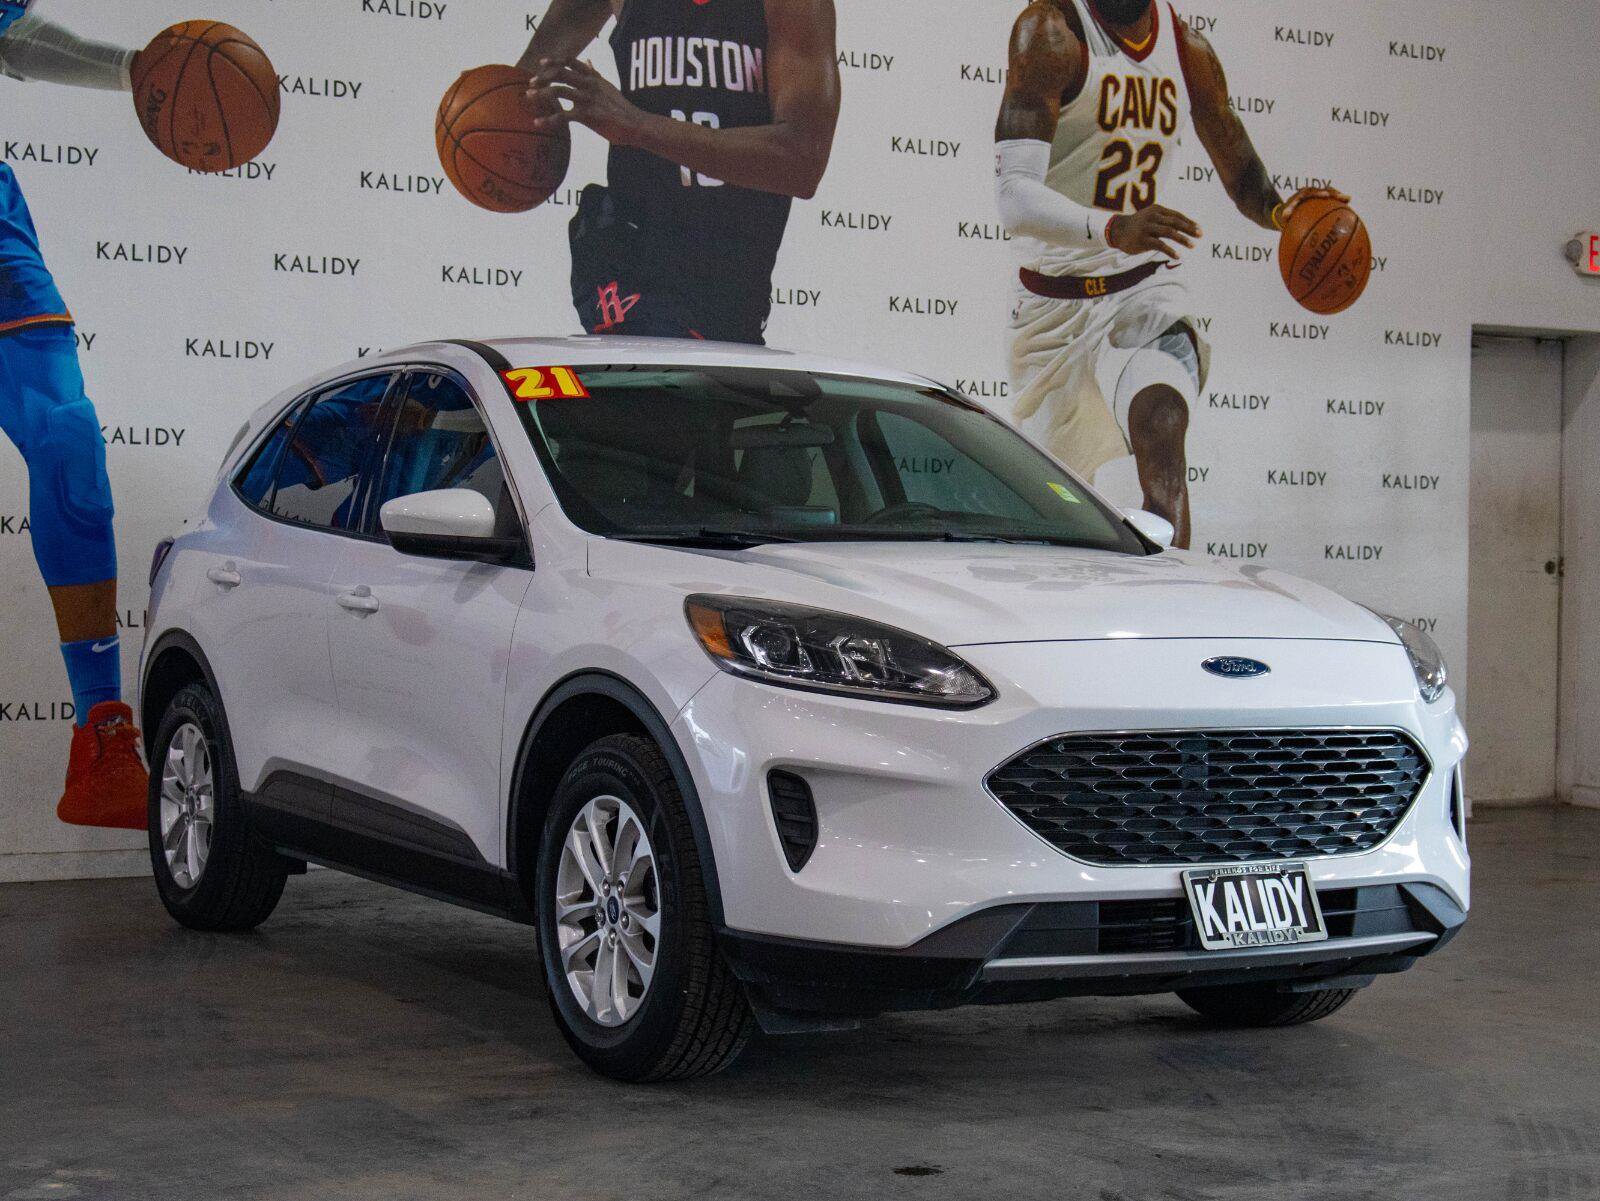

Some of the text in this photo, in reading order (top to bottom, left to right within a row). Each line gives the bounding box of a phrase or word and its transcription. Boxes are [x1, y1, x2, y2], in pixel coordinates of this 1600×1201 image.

[362, 0, 446, 20] KALIDY
[1275, 27, 1334, 47] KALIDY
[836, 50, 894, 71] ALIDY
[1389, 42, 1445, 61] KALIDY
[630, 36, 764, 92] HOUSTON
[961, 64, 1010, 84] KALI
[277, 75, 362, 99] KALIDY
[1100, 74, 1177, 137] CAVS
[1228, 97, 1275, 114] ALIDY
[1332, 107, 1389, 126] KALIDY
[5, 141, 99, 166] KALIDY
[892, 136, 960, 157] KALIDY
[361, 171, 444, 194] KALIDY
[1093, 138, 1162, 211] 23
[1387, 186, 1443, 204] KALIDY
[821, 210, 891, 231] KALIDY
[97, 241, 188, 264] KALIDY
[1212, 244, 1272, 262] KALIDY
[274, 253, 360, 276] KALIDY
[442, 265, 522, 287] KALIDY
[1085, 276, 1106, 295] CLE
[769, 288, 821, 306] LIDY
[889, 296, 958, 315] KALIDY
[1270, 323, 1329, 339] KALIDY
[1385, 330, 1441, 347] KALIDY
[186, 338, 274, 360] KALIDY
[505, 367, 584, 397] 21
[956, 379, 1008, 397] KALID
[1209, 393, 1270, 410] KALIDY
[1327, 399, 1384, 415] KALIDY
[892, 457, 955, 473] ALIDY
[1268, 470, 1326, 486] KALIDY
[1383, 474, 1439, 489] KALIDY
[1207, 543, 1267, 558] KALIDY
[1325, 545, 1382, 560] KALIDY
[1220, 659, 1257, 672] Ford
[0, 702, 75, 721] KALID
[1194, 876, 1308, 937] KALIDY
[1232, 929, 1295, 945] KALIDY
